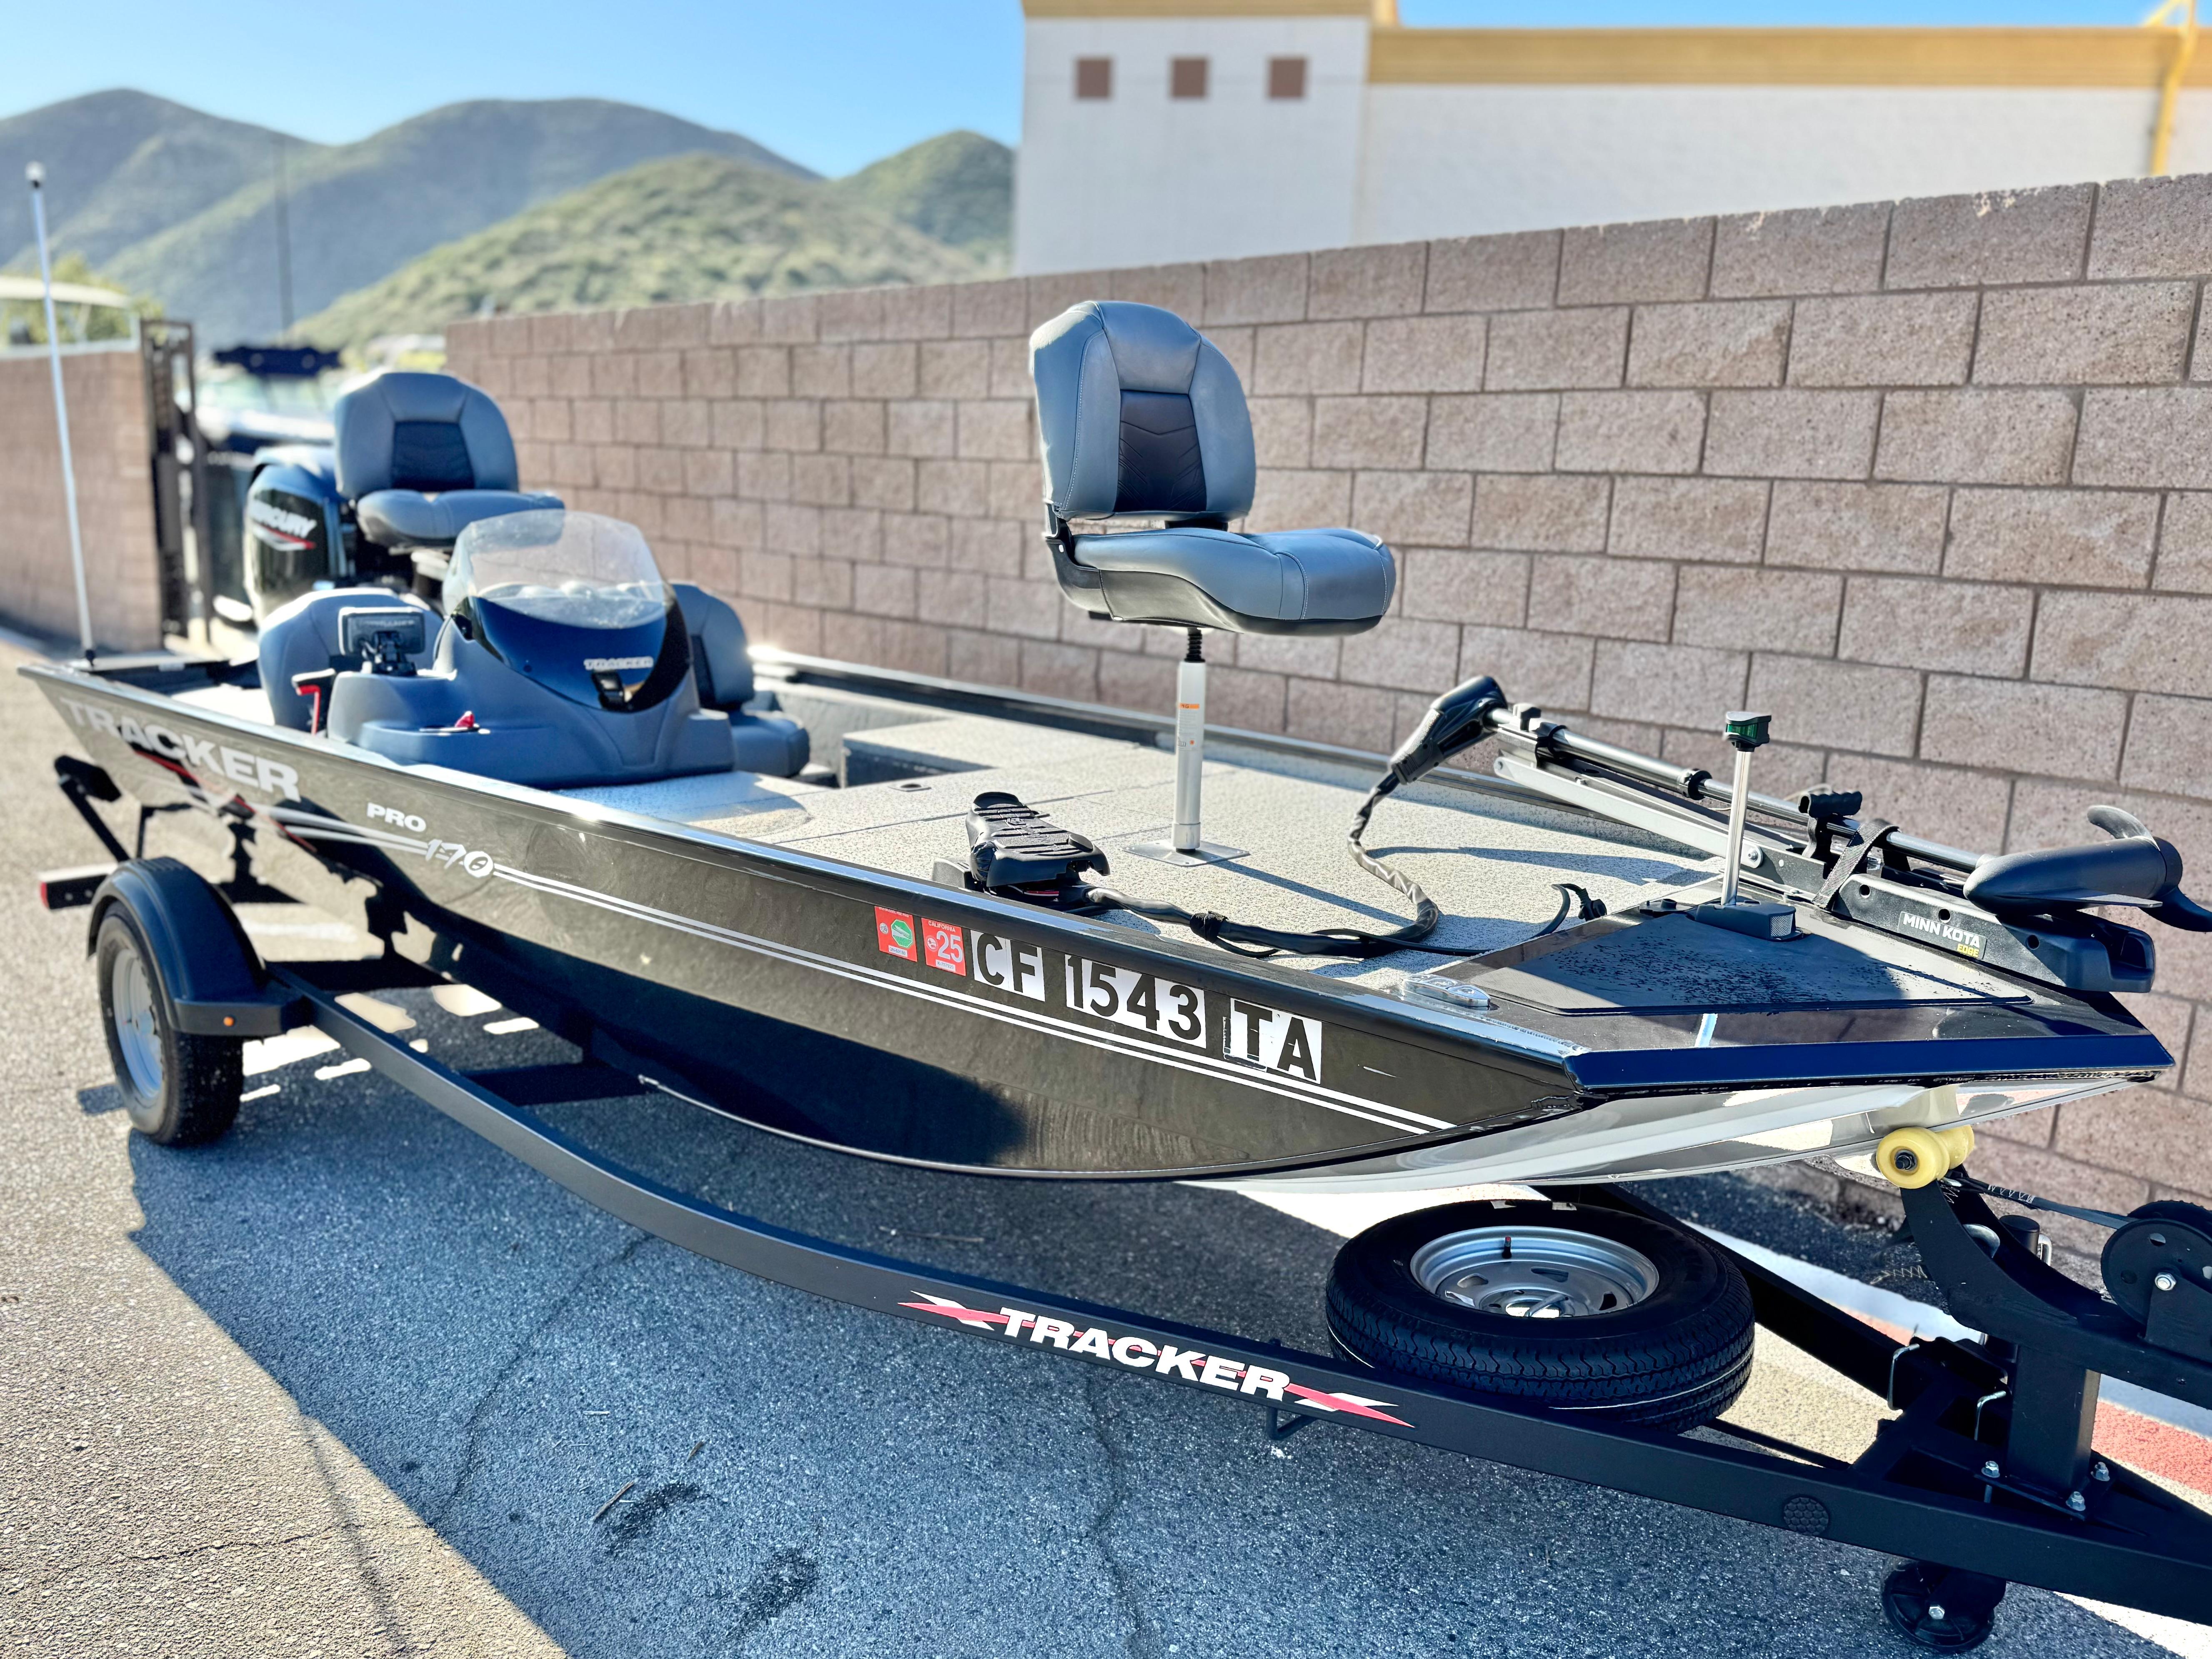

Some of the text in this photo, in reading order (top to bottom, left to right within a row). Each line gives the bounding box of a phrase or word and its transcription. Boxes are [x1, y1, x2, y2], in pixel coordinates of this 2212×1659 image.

[60, 697, 301, 803] TRACKER
[367, 802, 493, 878] PRO 170
[928, 921, 956, 933] CALIFORNIA
[936, 931, 963, 963] 25
[1903, 913, 1980, 948] MINN KOTA
[1957, 943, 1979, 958] EDGE
[976, 933, 1316, 1081] CF 1543 TA
[999, 1307, 1291, 1401] TRACKER
